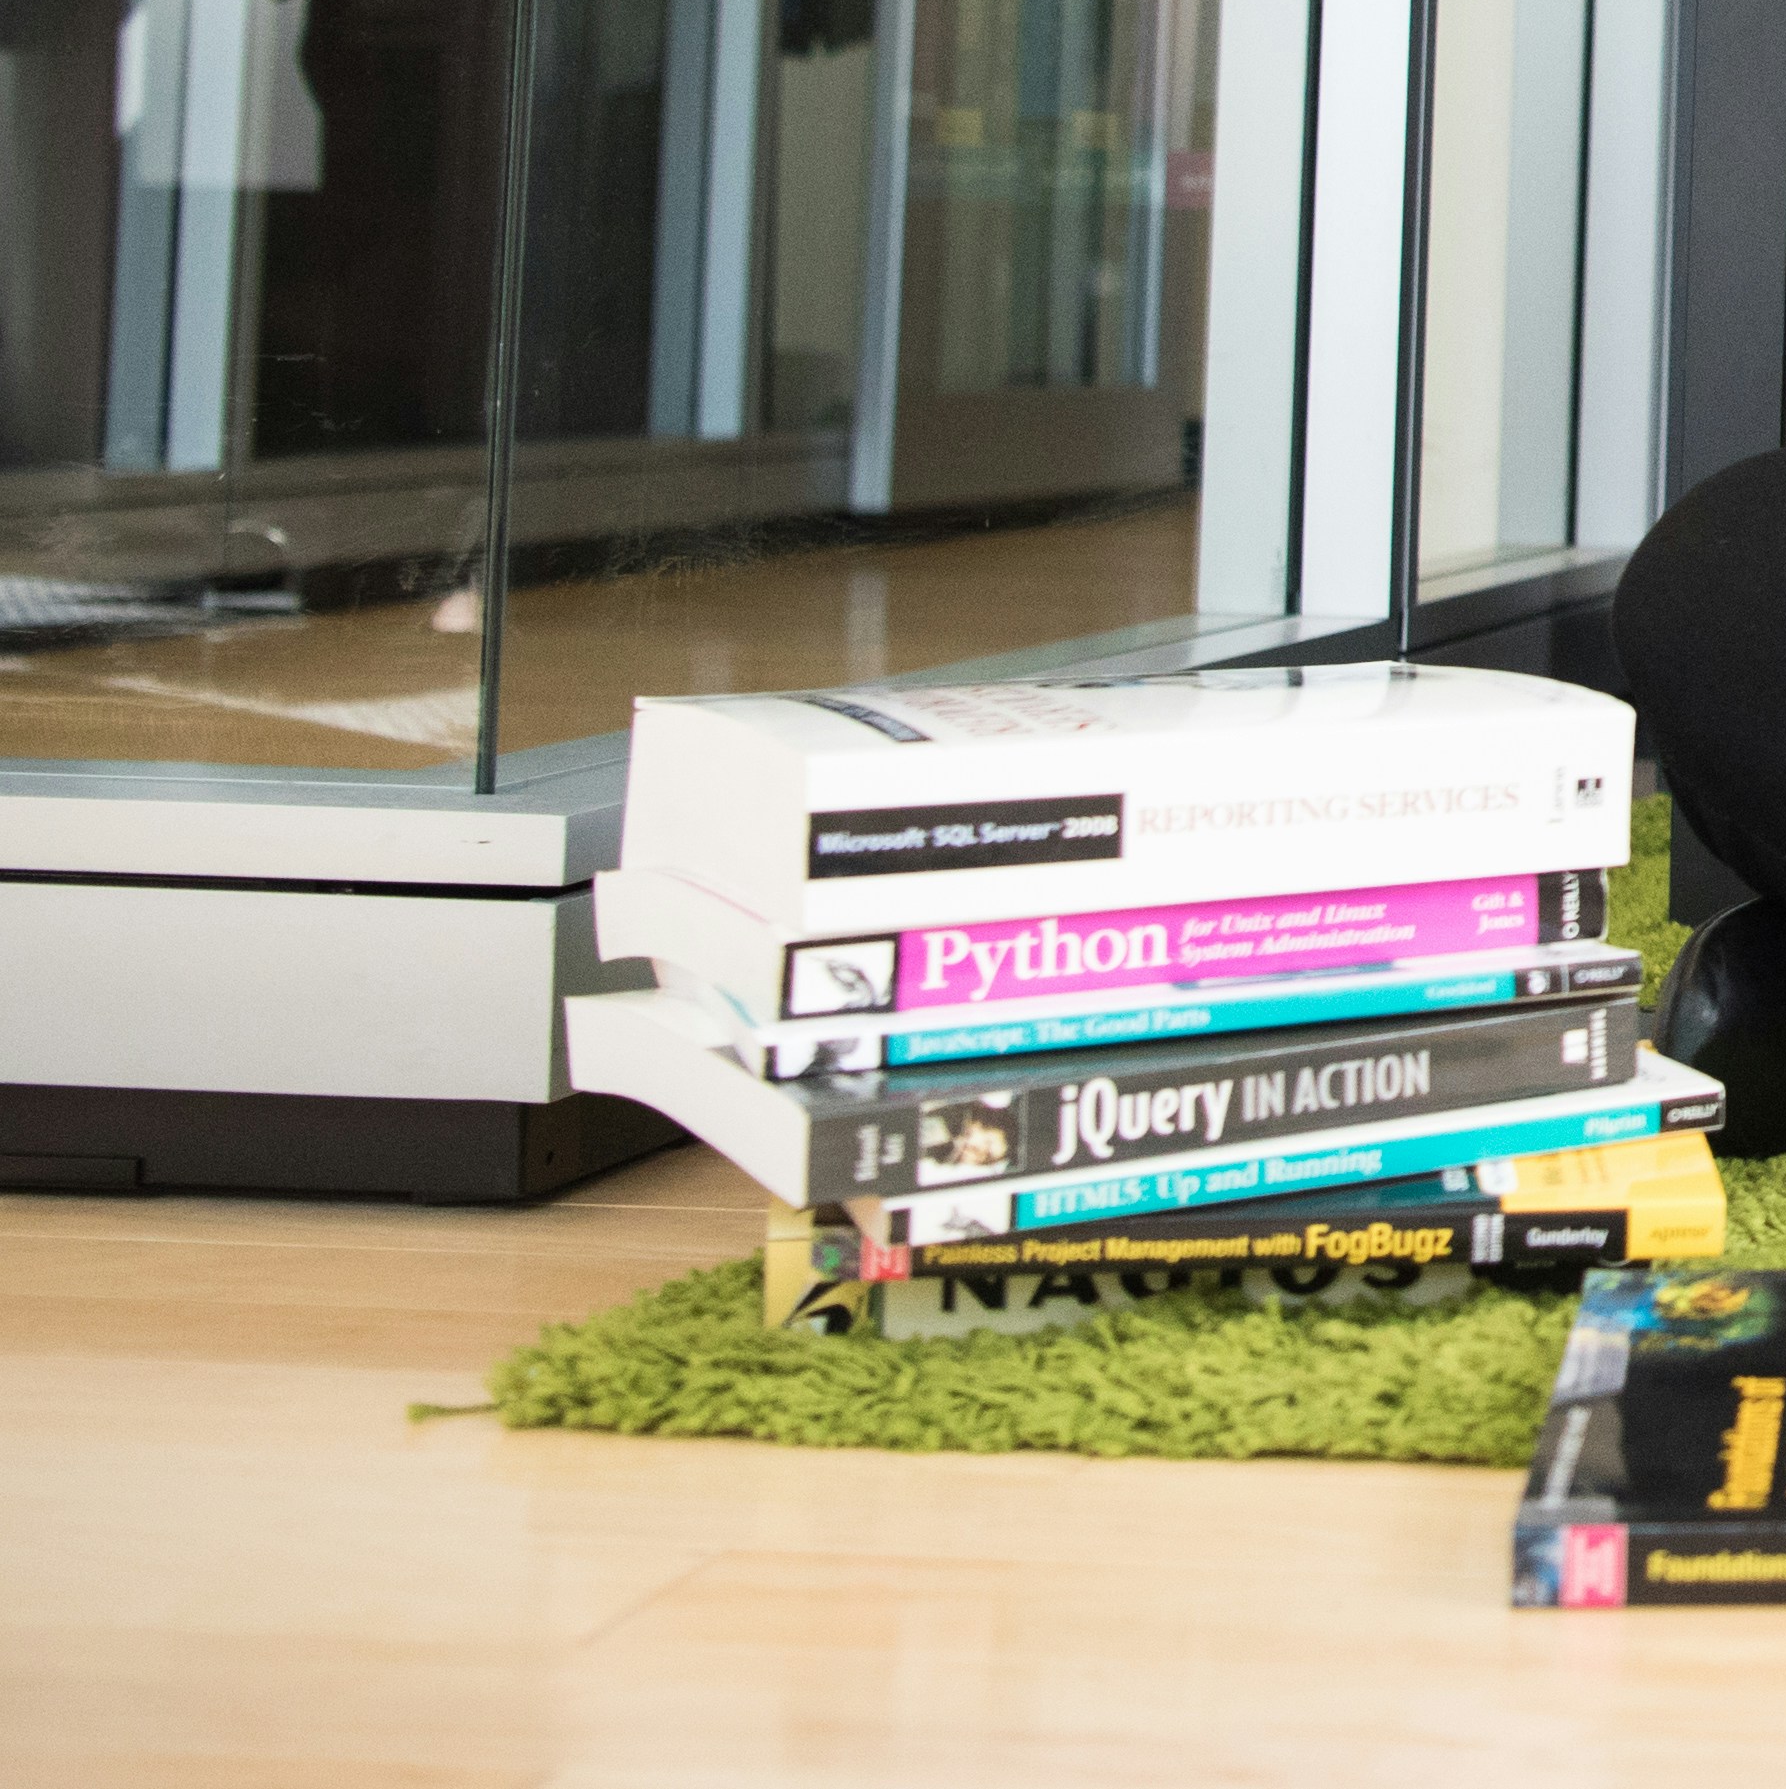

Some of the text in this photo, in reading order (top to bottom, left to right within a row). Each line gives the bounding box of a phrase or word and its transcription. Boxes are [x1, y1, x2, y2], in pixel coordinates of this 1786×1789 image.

[816, 783, 1522, 856] Microsoft SQL Server 2008 REPORTING SERVICES
[919, 900, 1387, 1002] Python for Unix and Linux
[1180, 923, 1417, 970] System Administration
[1035, 1005, 1212, 1044] The Good Parts
[1051, 1050, 1432, 1166] jQuery IN ACTION
[1032, 1148, 1383, 1219] HTML5: Up and Running
[921, 1242, 1019, 1266] Painless
[1021, 1239, 1102, 1269] Project
[1104, 1233, 1250, 1265] Management
[1252, 1232, 1302, 1258] with
[1303, 1222, 1455, 1265] FogBugz
